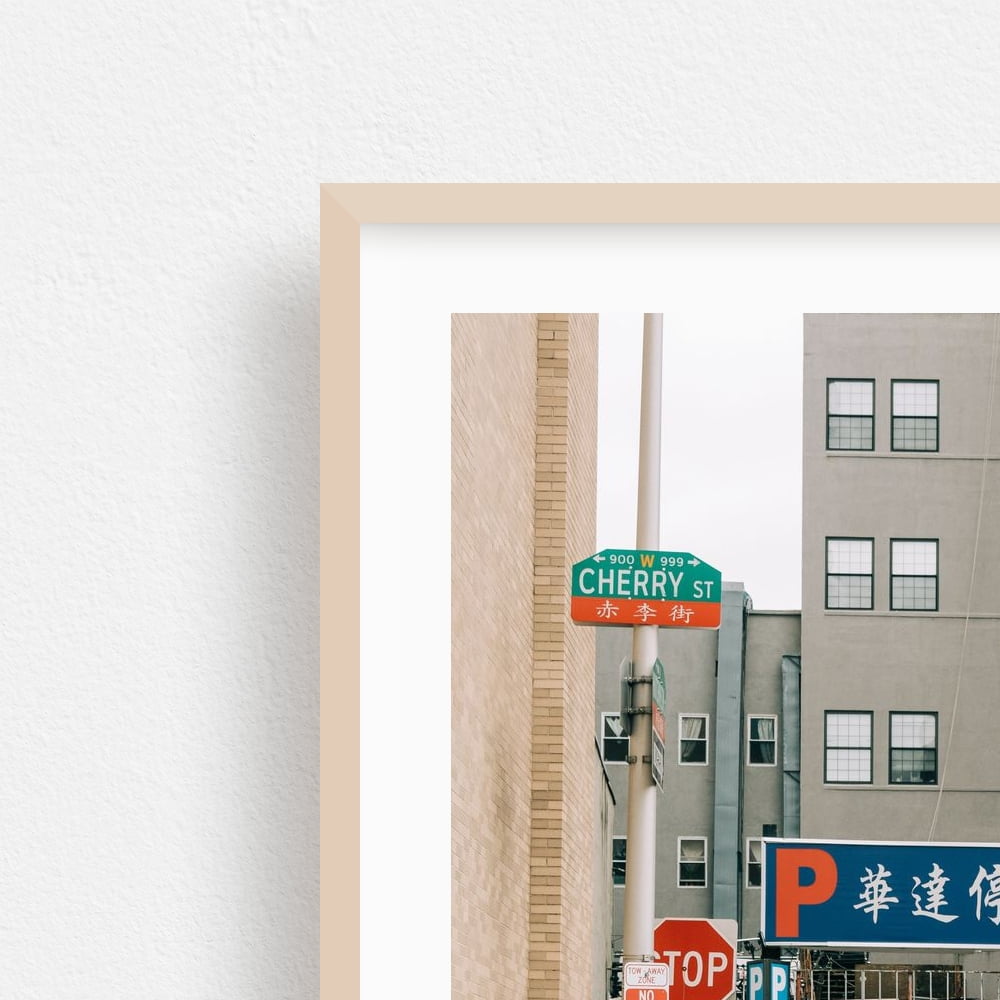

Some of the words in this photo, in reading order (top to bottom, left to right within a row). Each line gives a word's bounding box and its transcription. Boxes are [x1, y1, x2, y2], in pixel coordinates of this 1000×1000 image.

[610, 554, 635, 565] 900
[640, 554, 655, 568] W
[660, 556, 684, 567] 999
[578, 568, 684, 598] CHERRY
[693, 580, 714, 599] ST
[776, 848, 838, 937] P
[638, 976, 656, 984] ZONE
[653, 950, 729, 987] TOP
